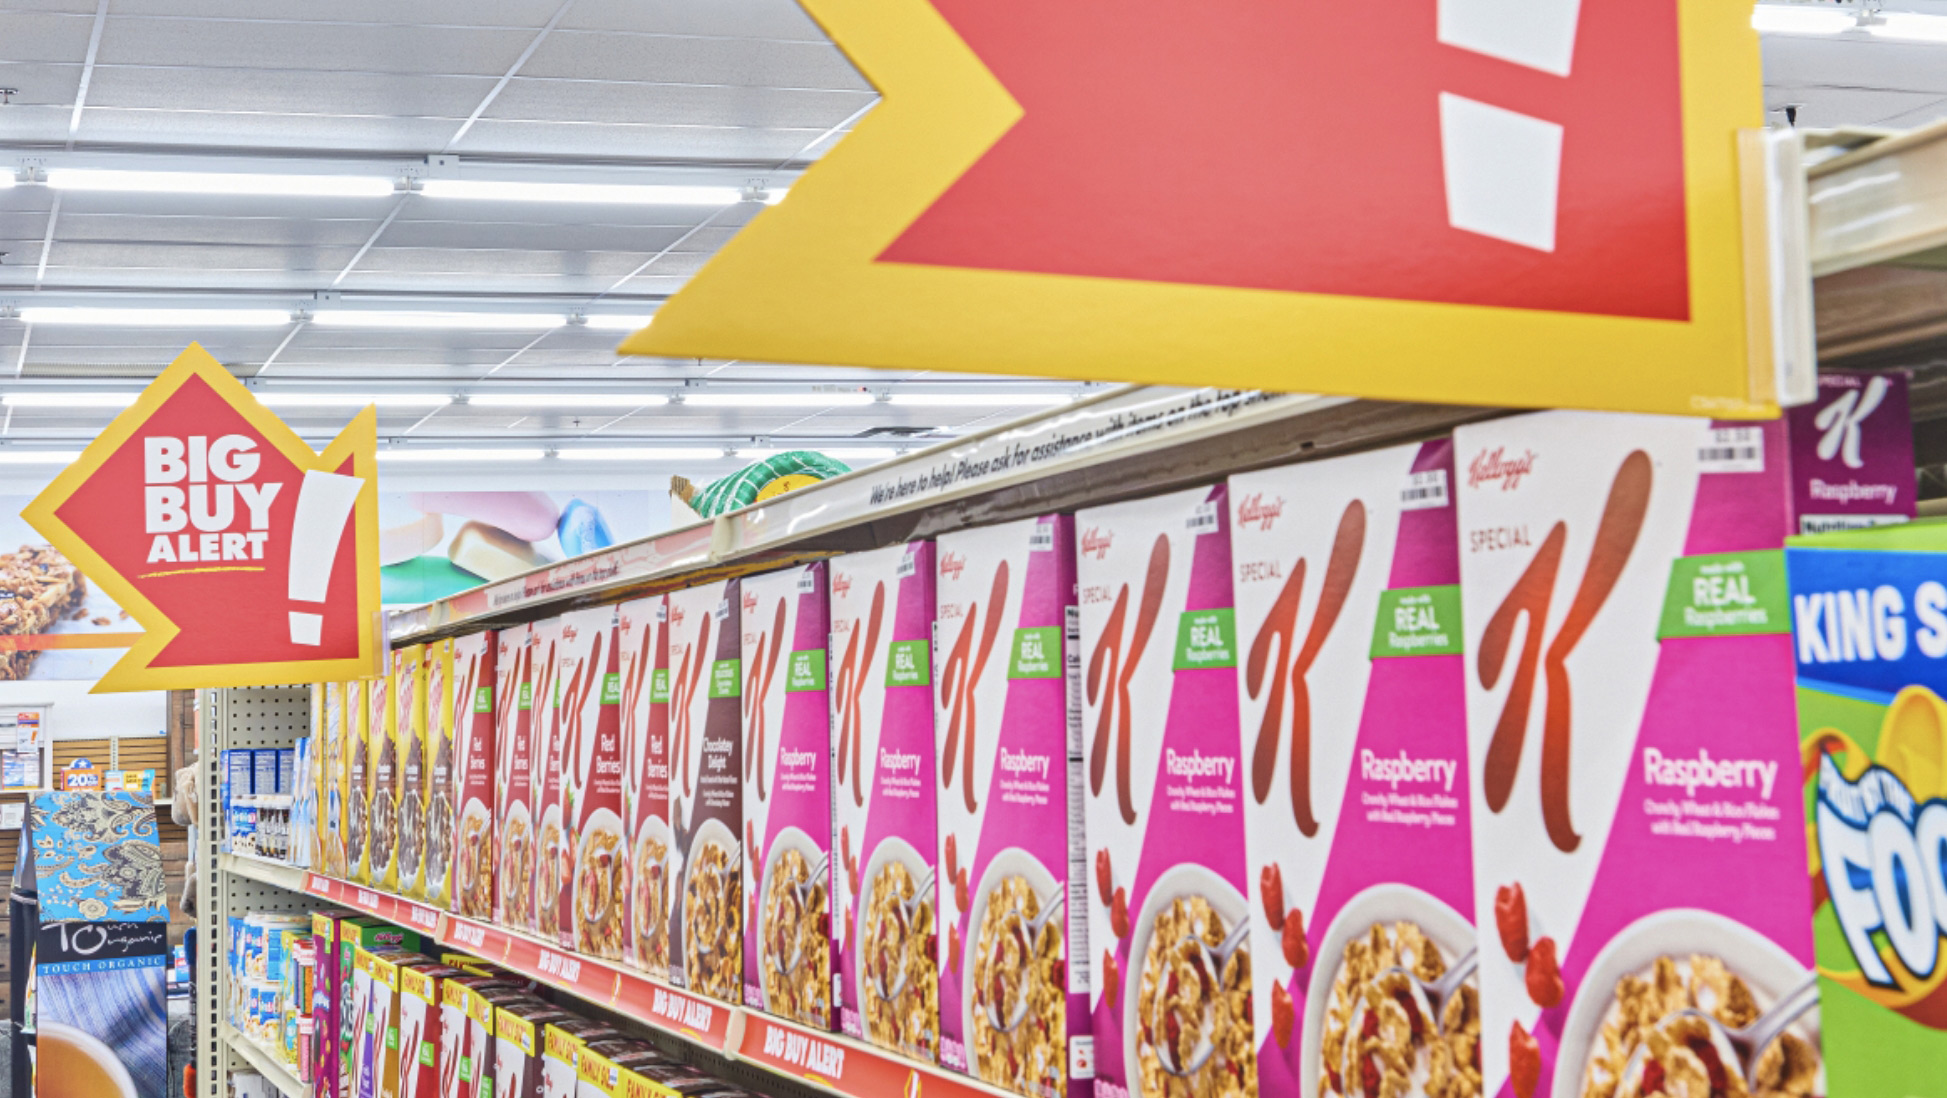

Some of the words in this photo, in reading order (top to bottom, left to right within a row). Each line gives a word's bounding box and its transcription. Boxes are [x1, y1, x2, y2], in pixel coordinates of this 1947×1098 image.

[144, 434, 260, 484] BIG
[870, 485, 894, 505] We're
[895, 476, 916, 497] here
[916, 473, 928, 492] to
[928, 462, 956, 491] help!
[955, 458, 990, 479] Please
[990, 445, 1012, 472] ask
[1012, 441, 1029, 468] for
[1031, 430, 1093, 461] assistance
[1468, 446, 1532, 492] Kellogg's
[1809, 478, 1897, 505] Raspberry
[144, 482, 282, 534] BUY
[1238, 492, 1282, 532] Kellogg's
[146, 532, 268, 564] ALERT
[1082, 526, 1113, 560] Kellogg's
[1470, 525, 1532, 553] SPECIAL
[1240, 560, 1282, 582] SPECIAL
[1083, 584, 1112, 604] SPECIAL
[1693, 574, 1756, 607] REAL
[1394, 606, 1440, 632] REAL
[1684, 606, 1768, 632] Raspberries
[1794, 584, 1908, 664] KING
[1190, 626, 1224, 647] REAL
[1388, 630, 1449, 652] Raspberries
[895, 653, 916, 670] REAL
[1020, 641, 1044, 660] REAL
[1186, 646, 1230, 664] Raspberries
[1478, 449, 1652, 854] K
[794, 660, 812, 677] REAL
[1016, 658, 1049, 674] Raspberries
[1087, 533, 1170, 826] K
[1247, 498, 1366, 838] K
[600, 734, 615, 752] Red
[651, 734, 662, 755] Red
[702, 736, 734, 757] Chocolatey
[596, 755, 621, 774] Berries
[648, 758, 668, 779] Berries
[708, 754, 726, 773] Delight
[780, 746, 816, 771] Raspberry
[880, 746, 922, 776] Raspberry
[1000, 746, 1050, 780] Raspberry
[1166, 747, 1236, 784] Raspberry
[1360, 748, 1458, 792] Raspberry
[1643, 746, 1779, 800] Raspberry
[42, 962, 90, 974] TOUCH
[98, 956, 162, 970] ORGANIC
[652, 988, 668, 1016] BIG
[666, 993, 686, 1022] BUY
[682, 999, 712, 1032] ALERT
[764, 1025, 784, 1058] BIG
[784, 1032, 809, 1066] BUY
[806, 1040, 844, 1080] ALERT
